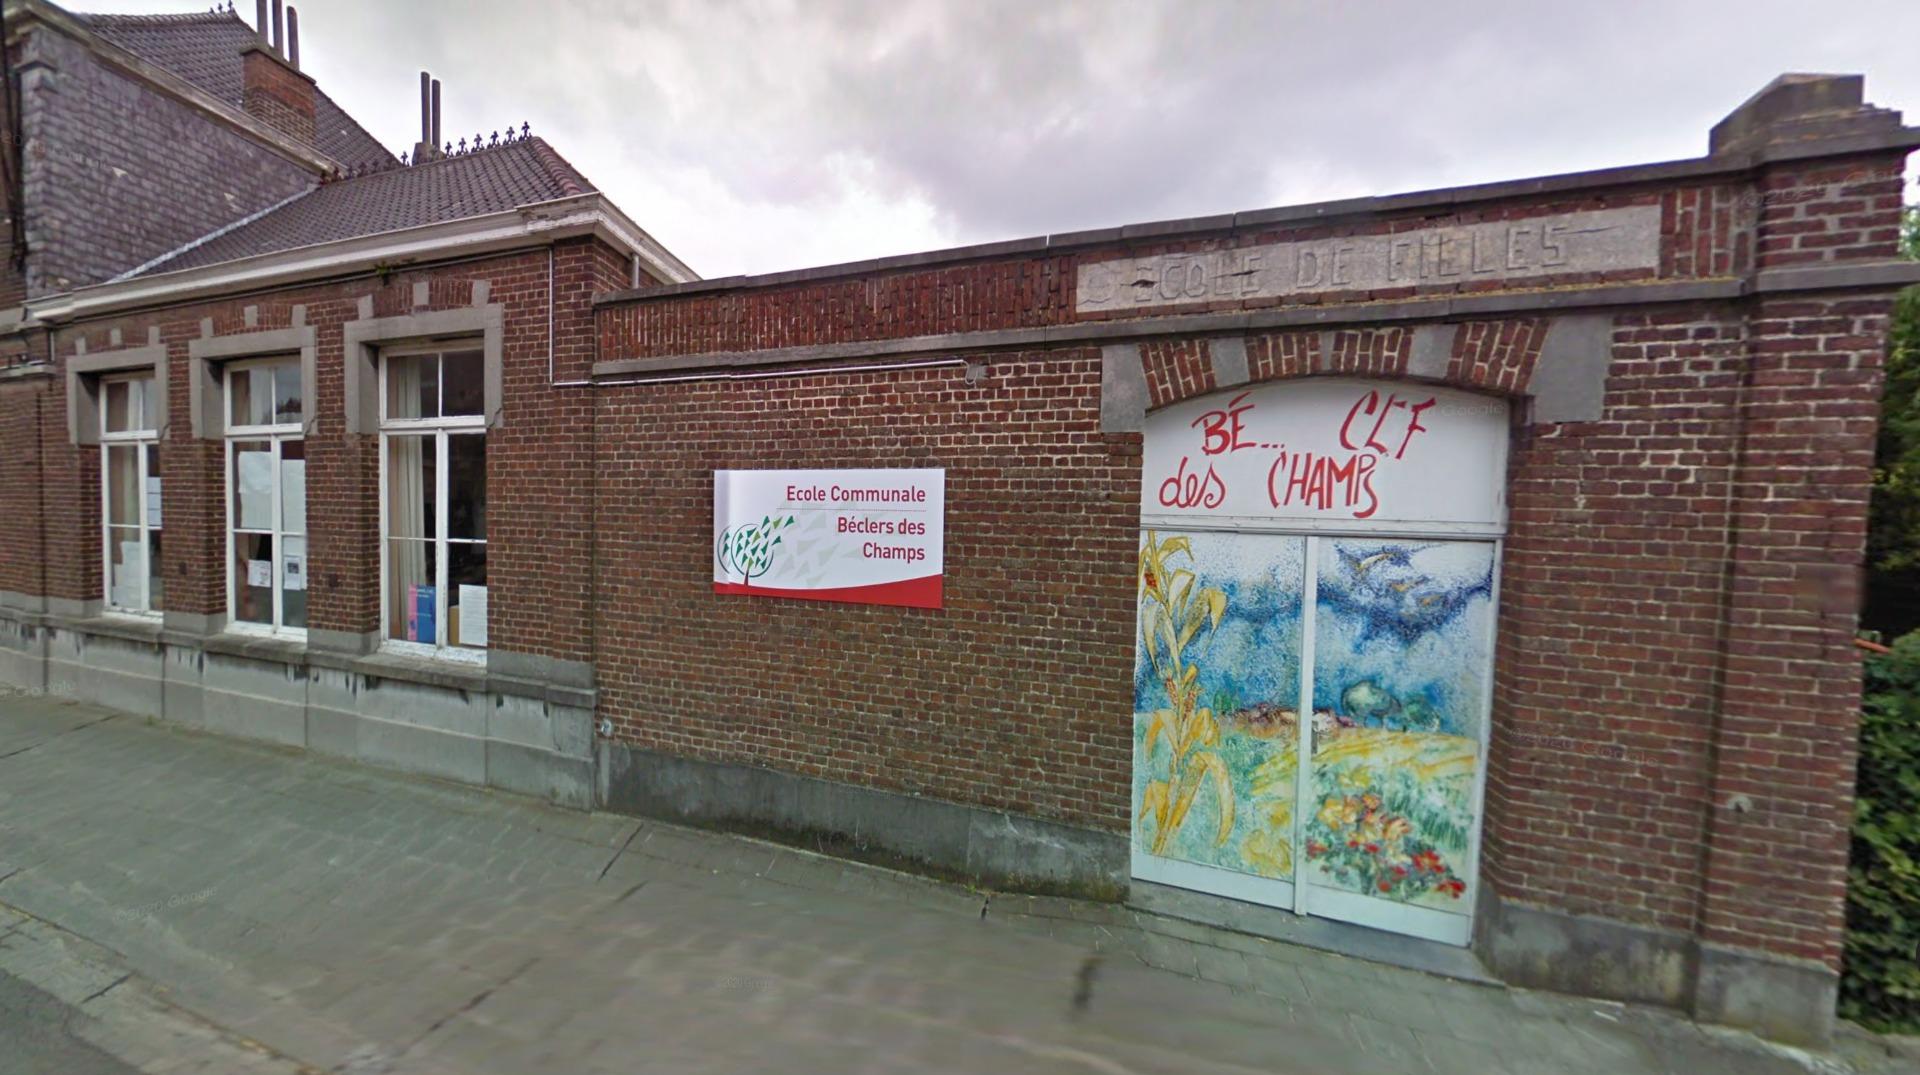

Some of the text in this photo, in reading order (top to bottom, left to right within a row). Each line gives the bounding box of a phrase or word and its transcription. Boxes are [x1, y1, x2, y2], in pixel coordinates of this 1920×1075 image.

[1296, 246, 1355, 289] DE
[1388, 224, 1567, 282] FILLES
[786, 485, 926, 503] Ecole Communale
[837, 516, 926, 535] Béclers des
[863, 542, 926, 563] Champs
